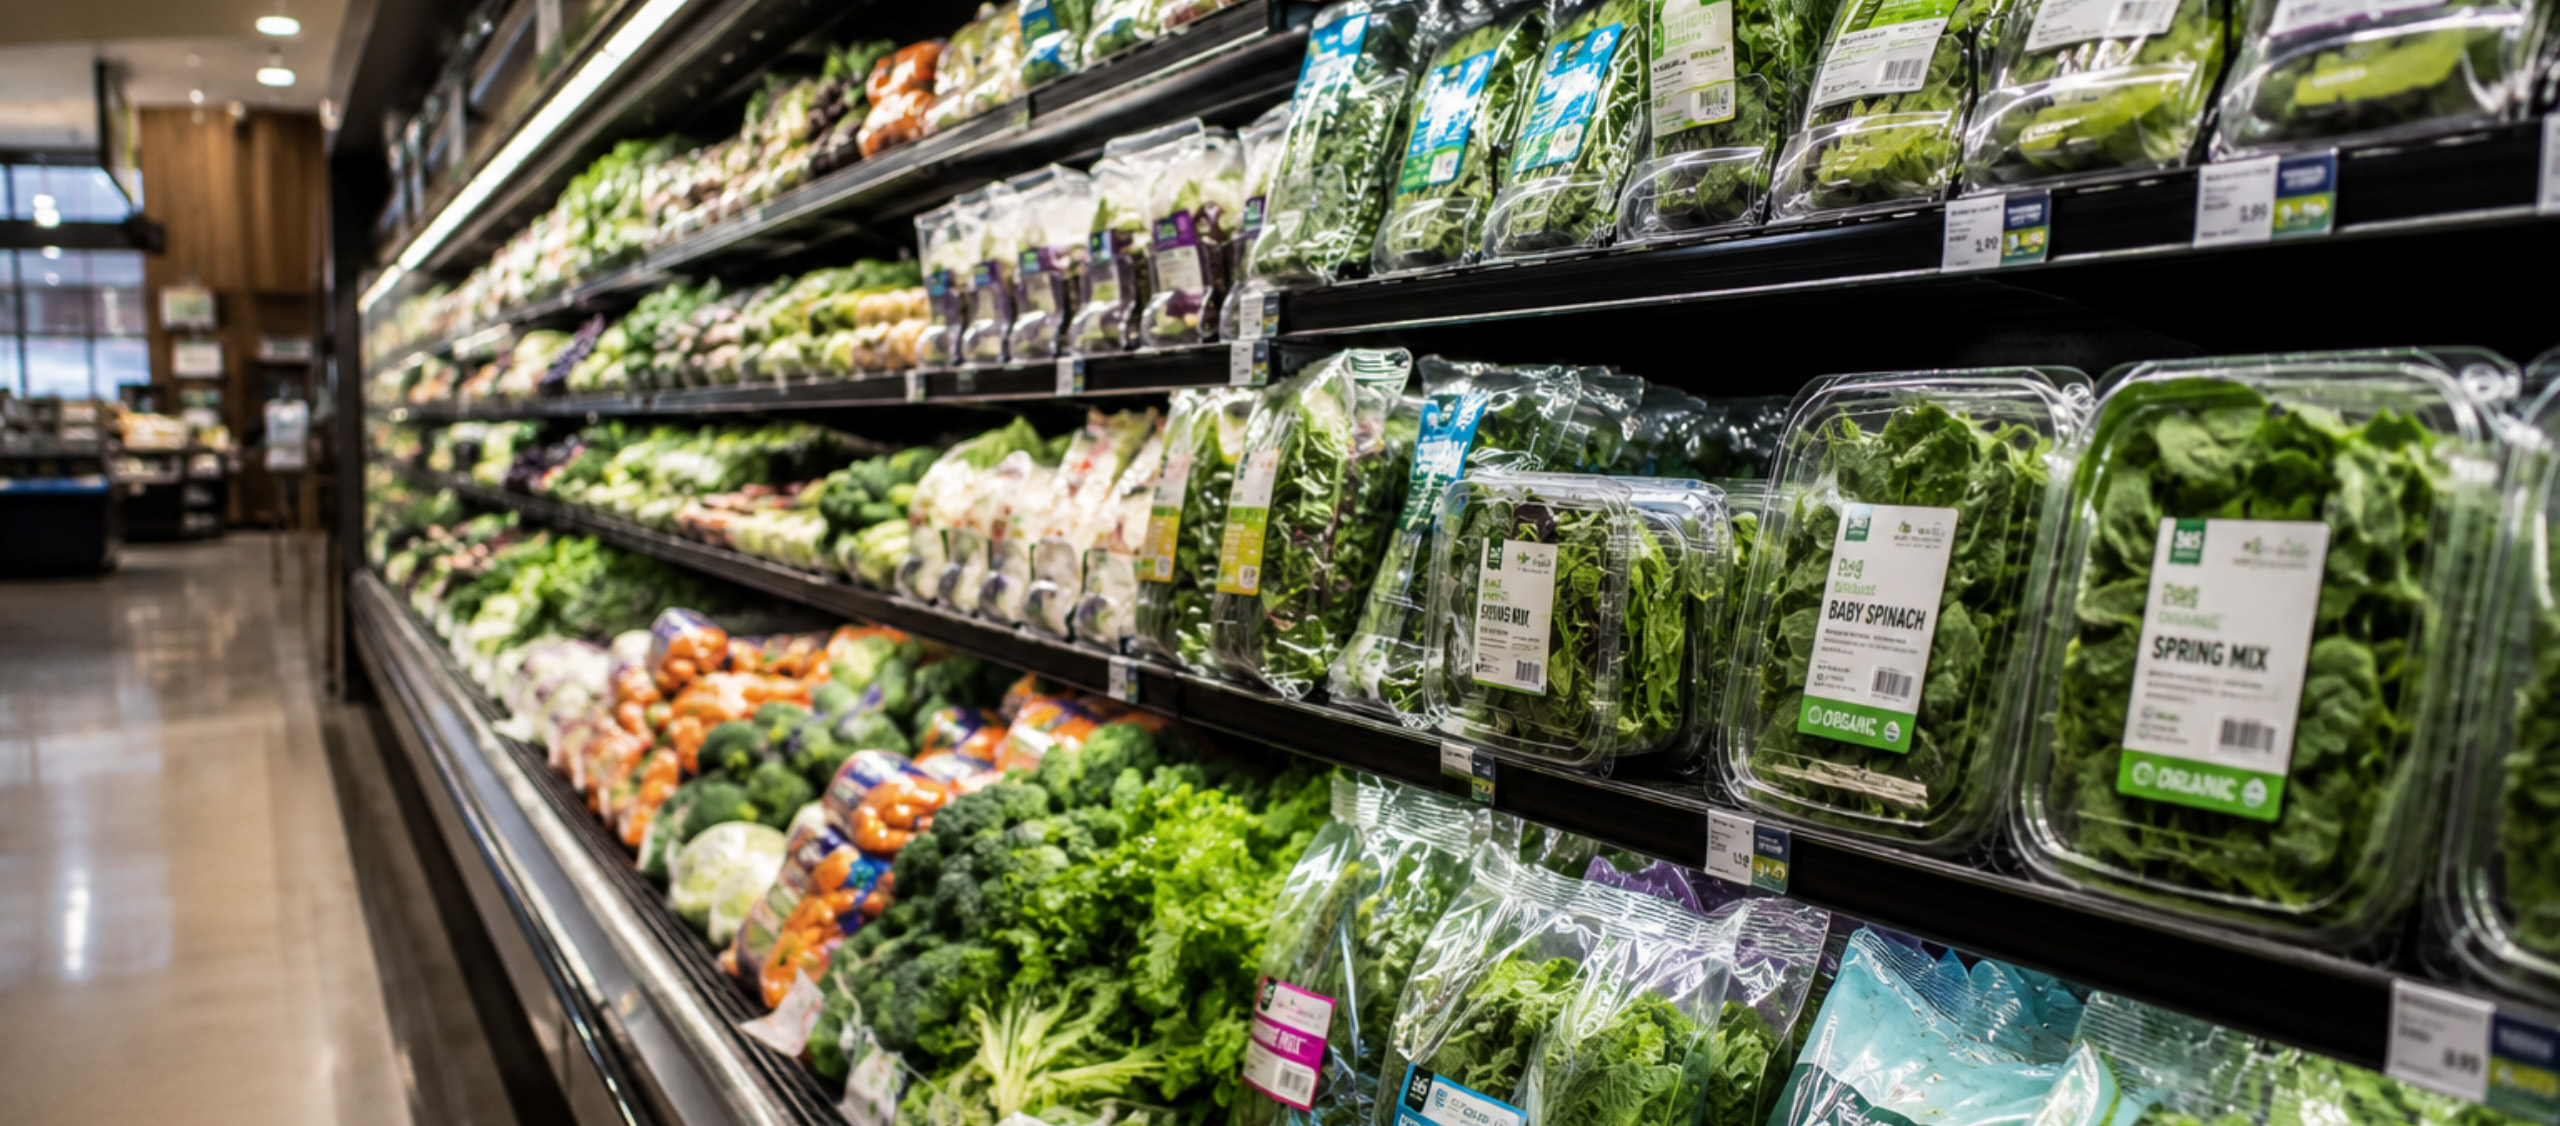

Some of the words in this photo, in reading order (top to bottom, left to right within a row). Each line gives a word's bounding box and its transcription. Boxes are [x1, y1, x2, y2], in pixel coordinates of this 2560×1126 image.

[2174, 529, 2203, 549] 365
[1828, 599, 1864, 623] BABY
[1865, 603, 1927, 631] SPINACH
[2152, 636, 2225, 666] SPRING
[2229, 643, 2270, 671] MIX
